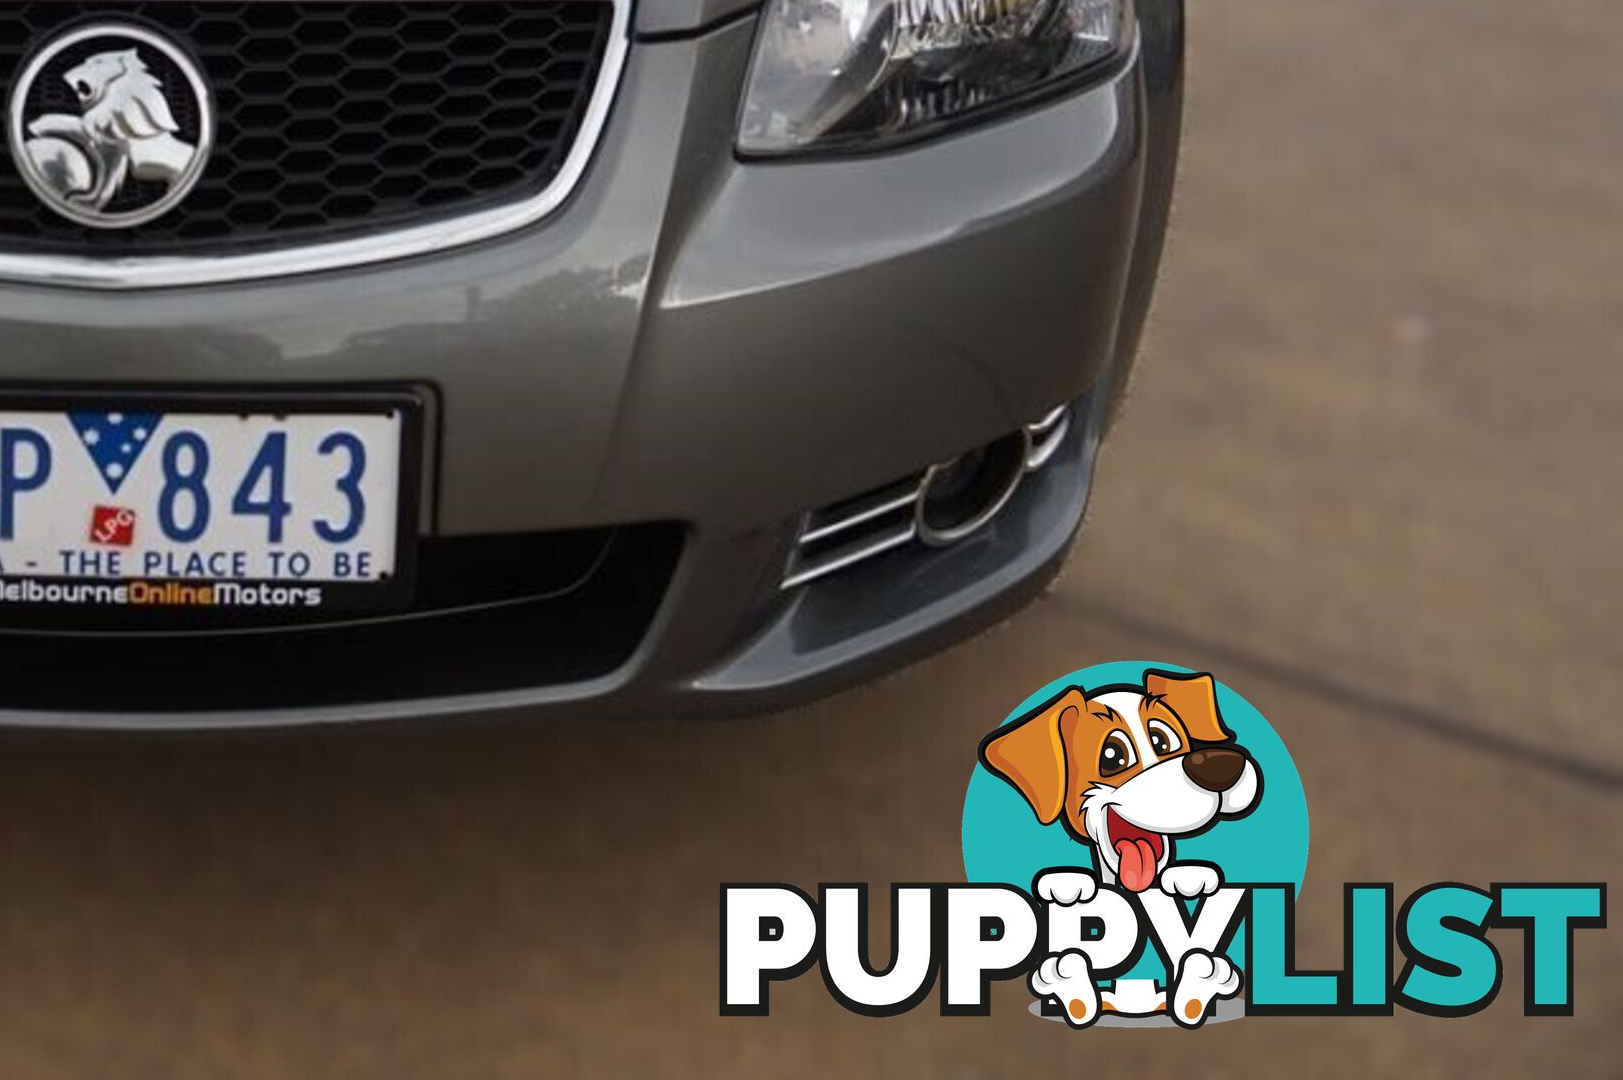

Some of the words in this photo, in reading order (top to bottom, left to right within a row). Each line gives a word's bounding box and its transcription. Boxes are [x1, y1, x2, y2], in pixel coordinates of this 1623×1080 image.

[158, 430, 367, 544] 843
[60, 551, 121, 576] THE
[144, 551, 247, 578] PLACE
[268, 552, 312, 578] TO
[334, 552, 372, 579] BE
